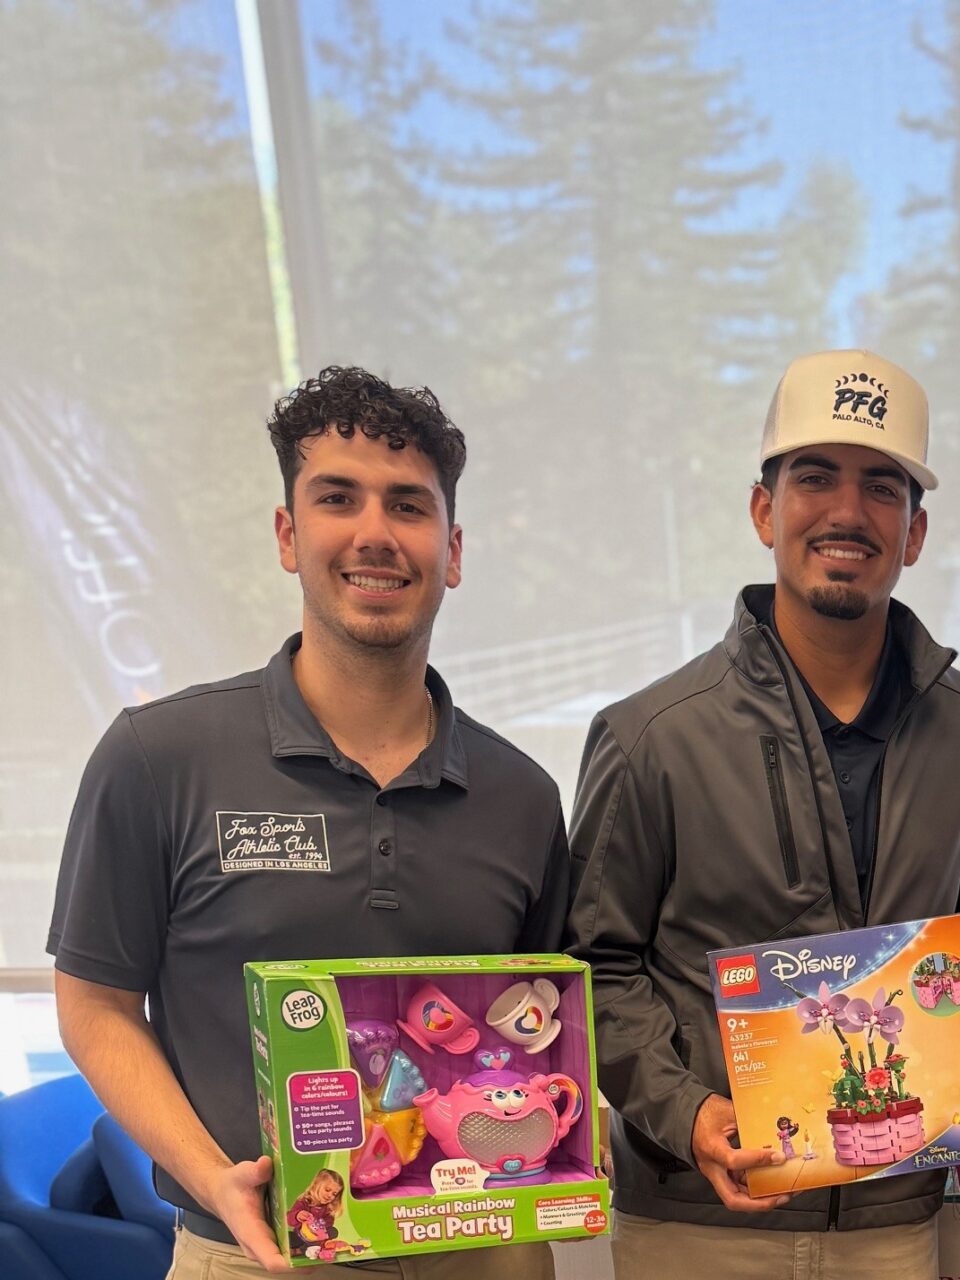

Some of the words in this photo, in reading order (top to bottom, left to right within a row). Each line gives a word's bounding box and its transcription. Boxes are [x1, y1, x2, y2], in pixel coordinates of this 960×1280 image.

[834, 388, 888, 421] PFG
[853, 415, 874, 427] ALTO,
[875, 422, 885, 431] CA
[225, 819, 257, 840] Fox
[260, 816, 306, 837] Sports
[227, 837, 281, 860] Athletic
[284, 835, 318, 853] Club
[224, 861, 263, 870] DESIGNED
[291, 861, 328, 869] ANGELES
[722, 965, 756, 985] LEGO
[285, 994, 316, 1013] Leap
[290, 1006, 321, 1025] Frog
[727, 1018, 749, 1032] 9+
[733, 1050, 749, 1063] 641
[435, 1168, 456, 1179] Try
[457, 1165, 477, 1176] Me!
[392, 1201, 451, 1219] Musical
[453, 1197, 516, 1214] Rainbow
[398, 1221, 442, 1243] Tea
[446, 1213, 513, 1241] Party
